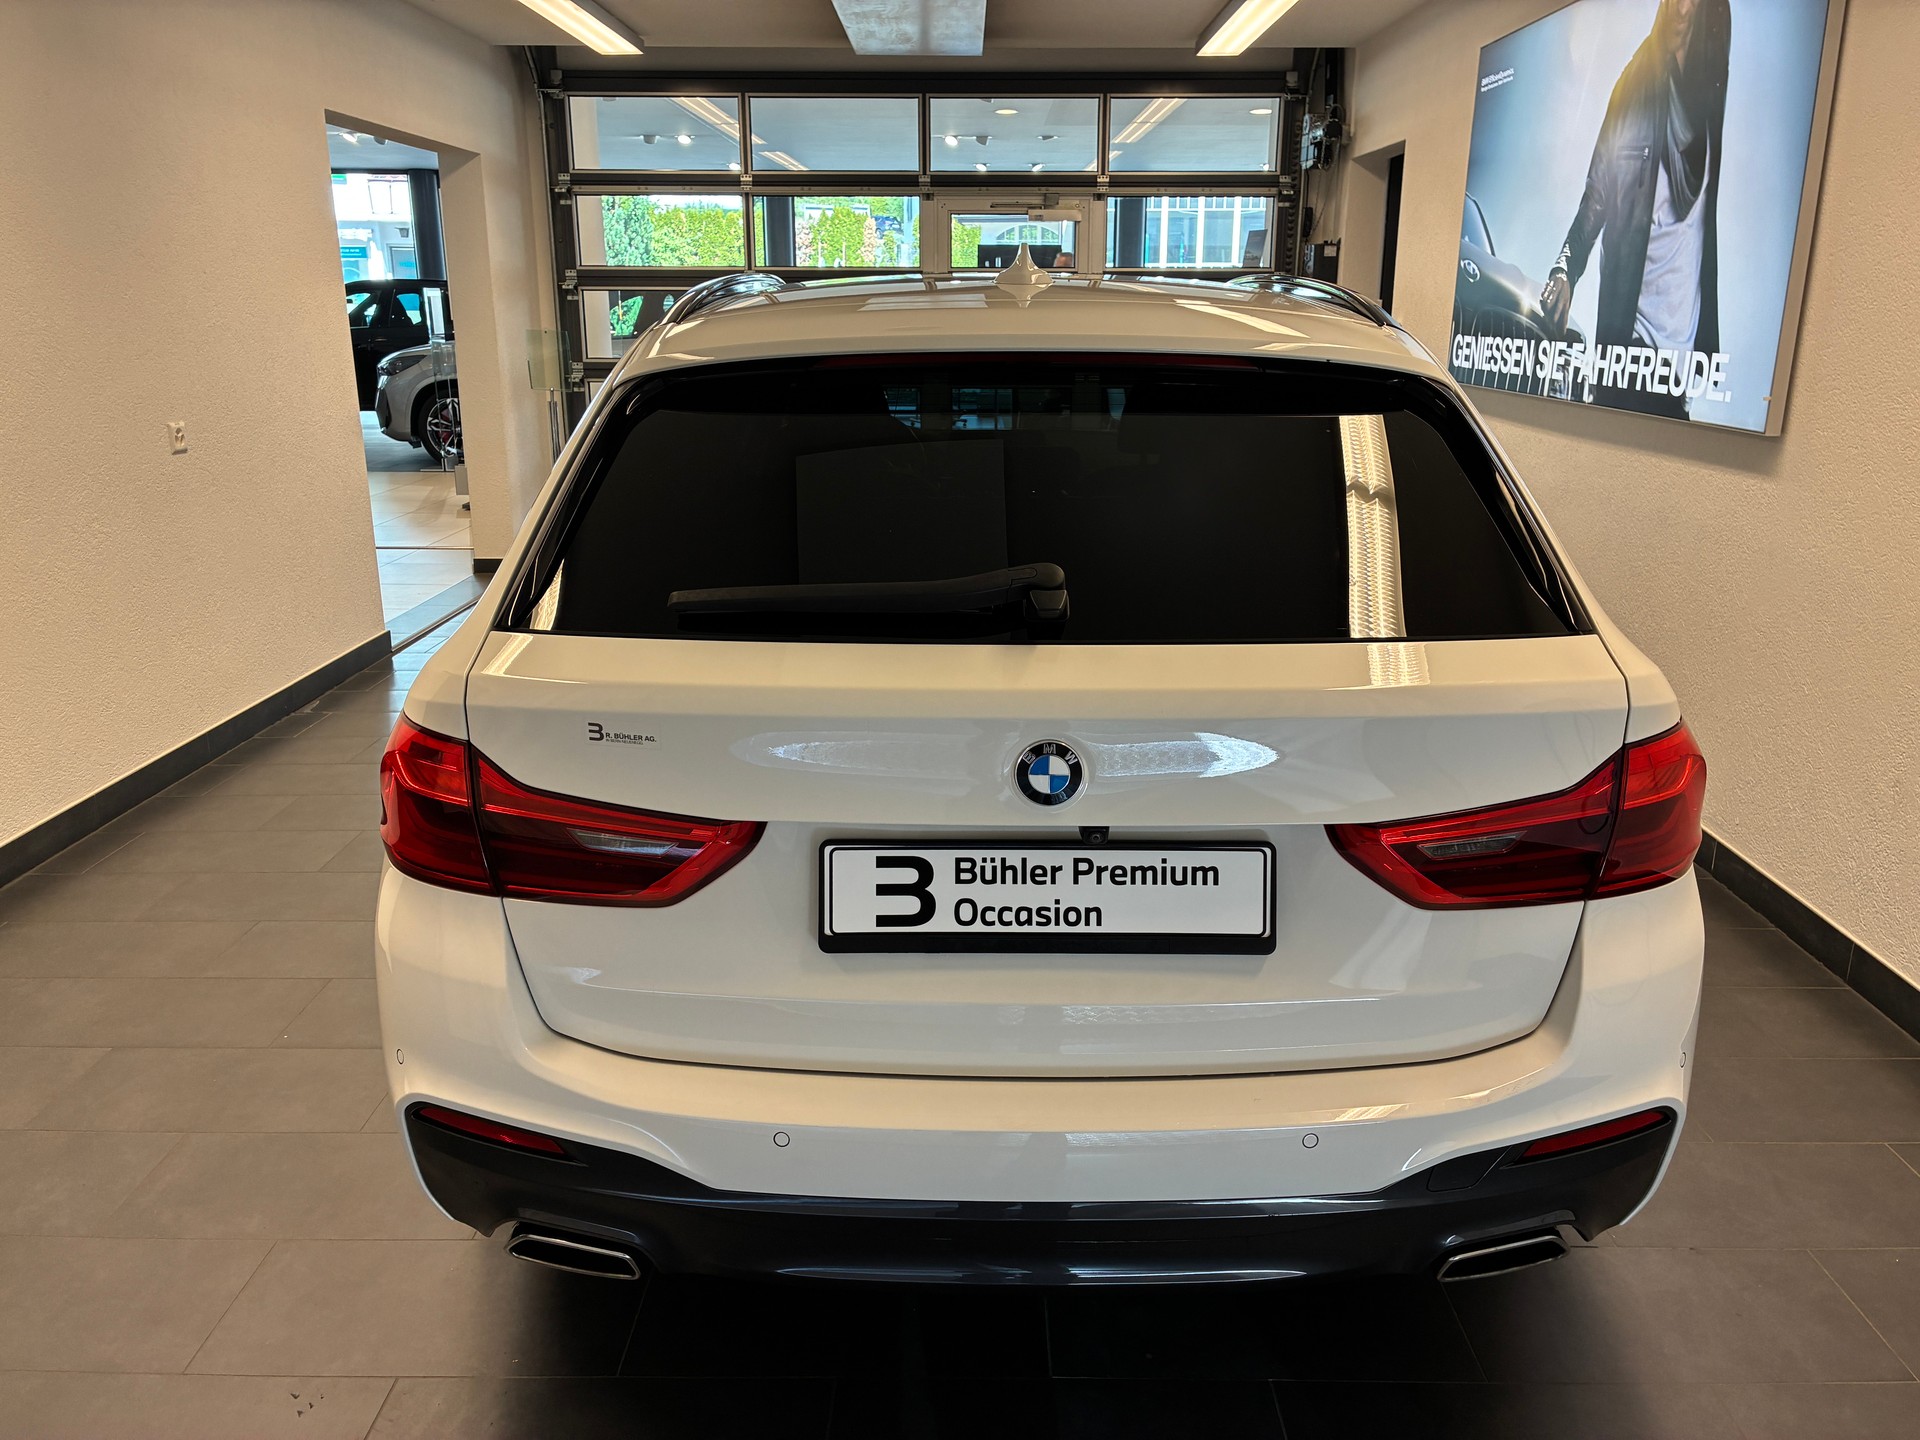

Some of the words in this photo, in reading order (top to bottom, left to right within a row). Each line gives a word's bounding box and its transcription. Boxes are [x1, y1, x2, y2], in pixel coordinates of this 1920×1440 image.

[1452, 333, 1536, 377] GENIESSEN
[1536, 339, 1568, 381] SIE
[1568, 342, 1732, 403] FAHRFREUDE.
[614, 732, 643, 741] BÜHLER
[644, 735, 657, 743] AG.
[1022, 743, 1078, 765] BMW
[954, 856, 1063, 886] Bühler
[1072, 857, 1220, 887] Premium
[953, 897, 1103, 927] Occasion
